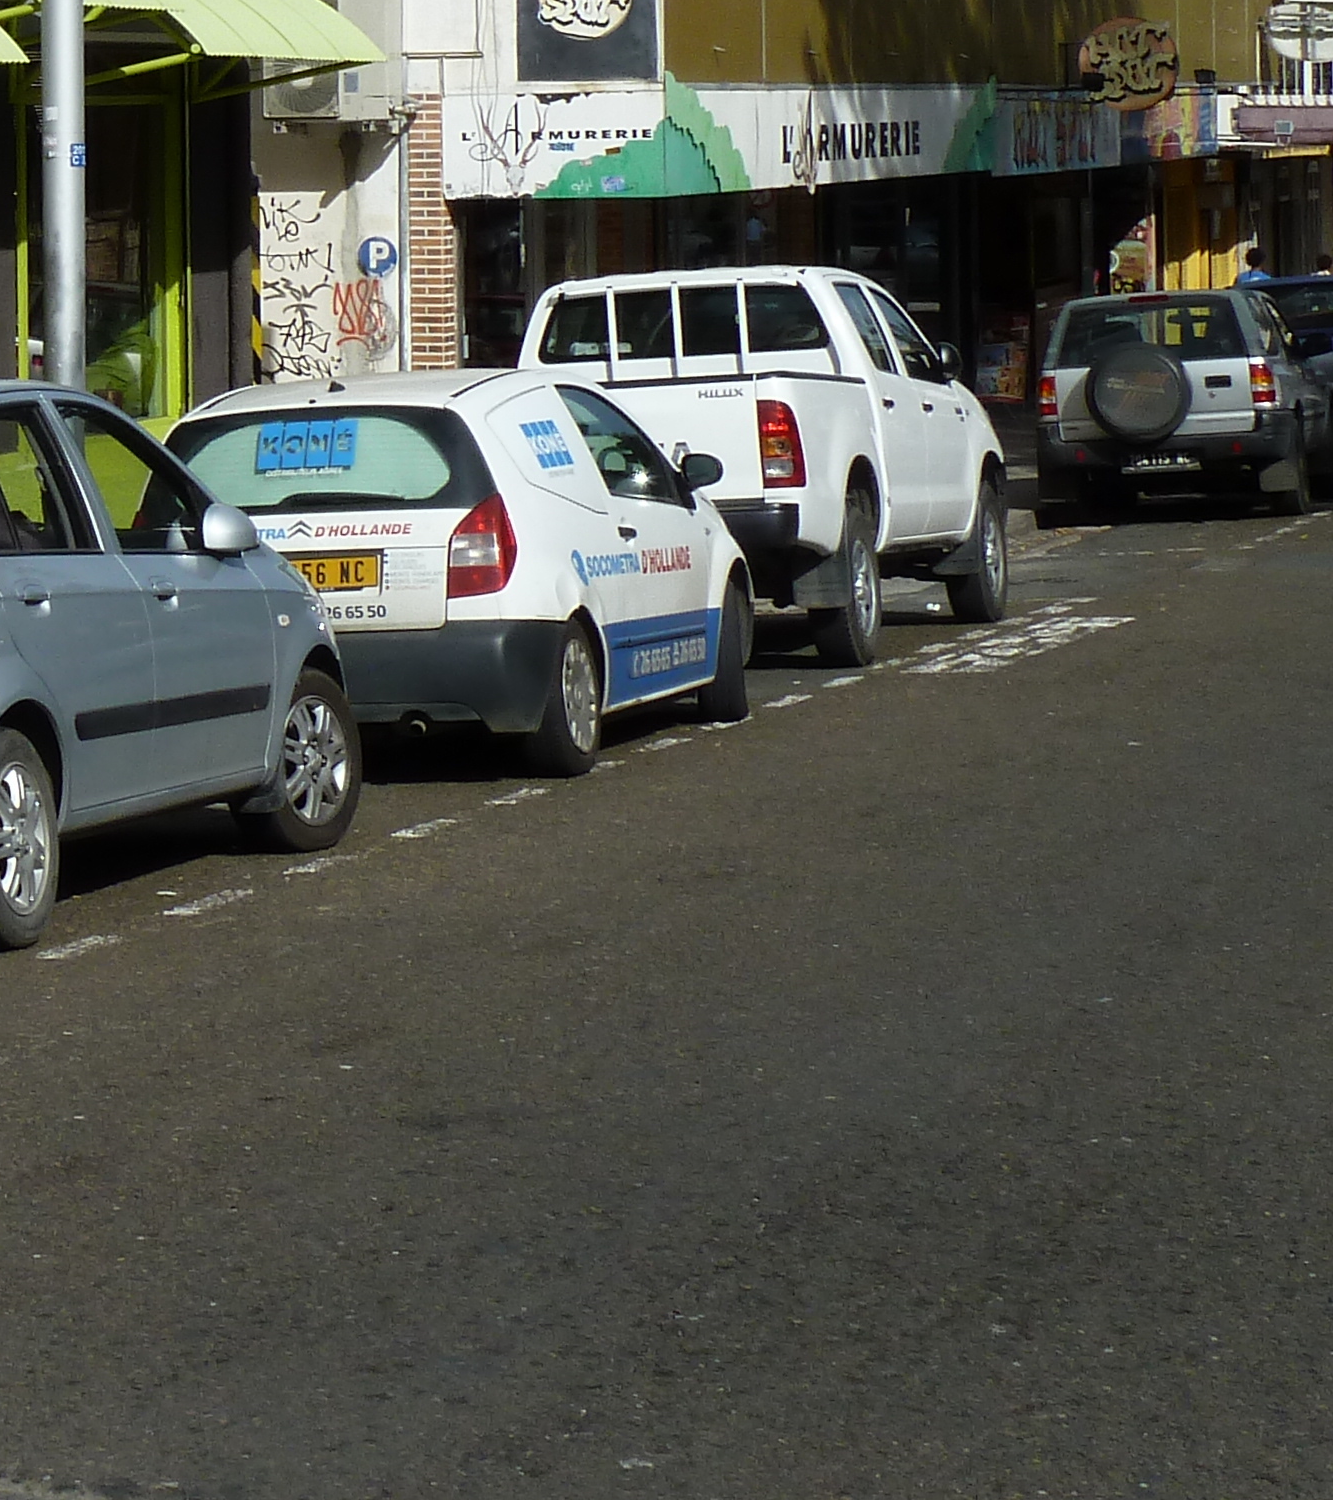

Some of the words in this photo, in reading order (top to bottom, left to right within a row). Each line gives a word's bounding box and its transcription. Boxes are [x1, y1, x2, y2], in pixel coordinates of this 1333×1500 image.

[368, 241, 390, 269] P
[697, 387, 744, 399] HILUX
[257, 528, 286, 541] TRA
[314, 523, 413, 538] D'HOLLANDE
[586, 551, 641, 578] SOCOMETRA
[641, 545, 692, 575] D'HOLLANDE
[294, 562, 326, 585] 56
[339, 560, 365, 584] NC
[345, 605, 364, 619] 65
[367, 604, 387, 618] 50
